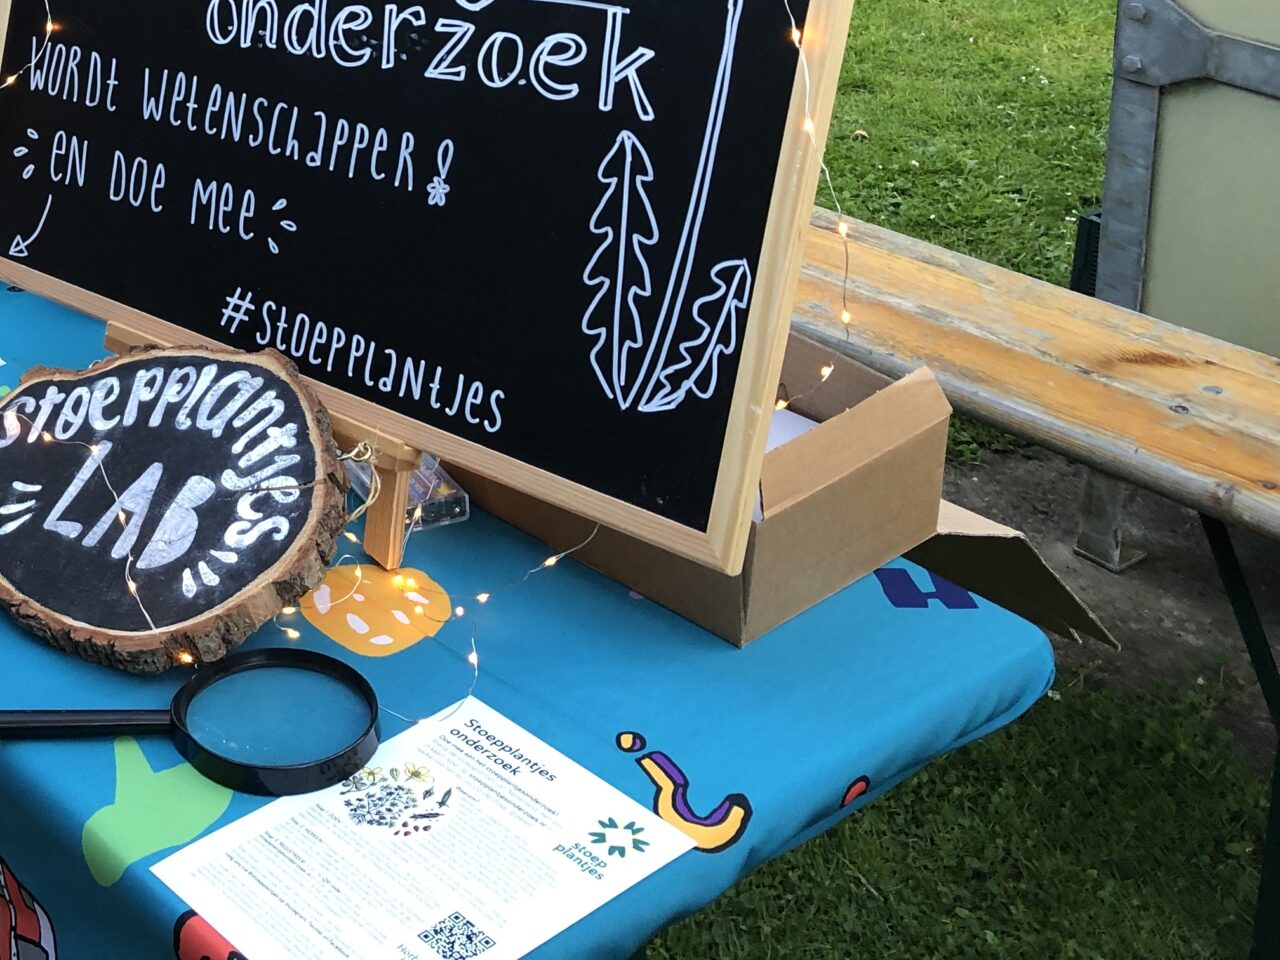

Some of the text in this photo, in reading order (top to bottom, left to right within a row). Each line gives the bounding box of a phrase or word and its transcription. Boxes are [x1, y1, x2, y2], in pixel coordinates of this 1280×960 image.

[43, 440, 216, 570] LAB
[450, 728, 522, 777] onderzoek
[463, 718, 557, 782] Stoepplantjes
[552, 843, 605, 881] plantjes
[572, 842, 608, 869] stoep
